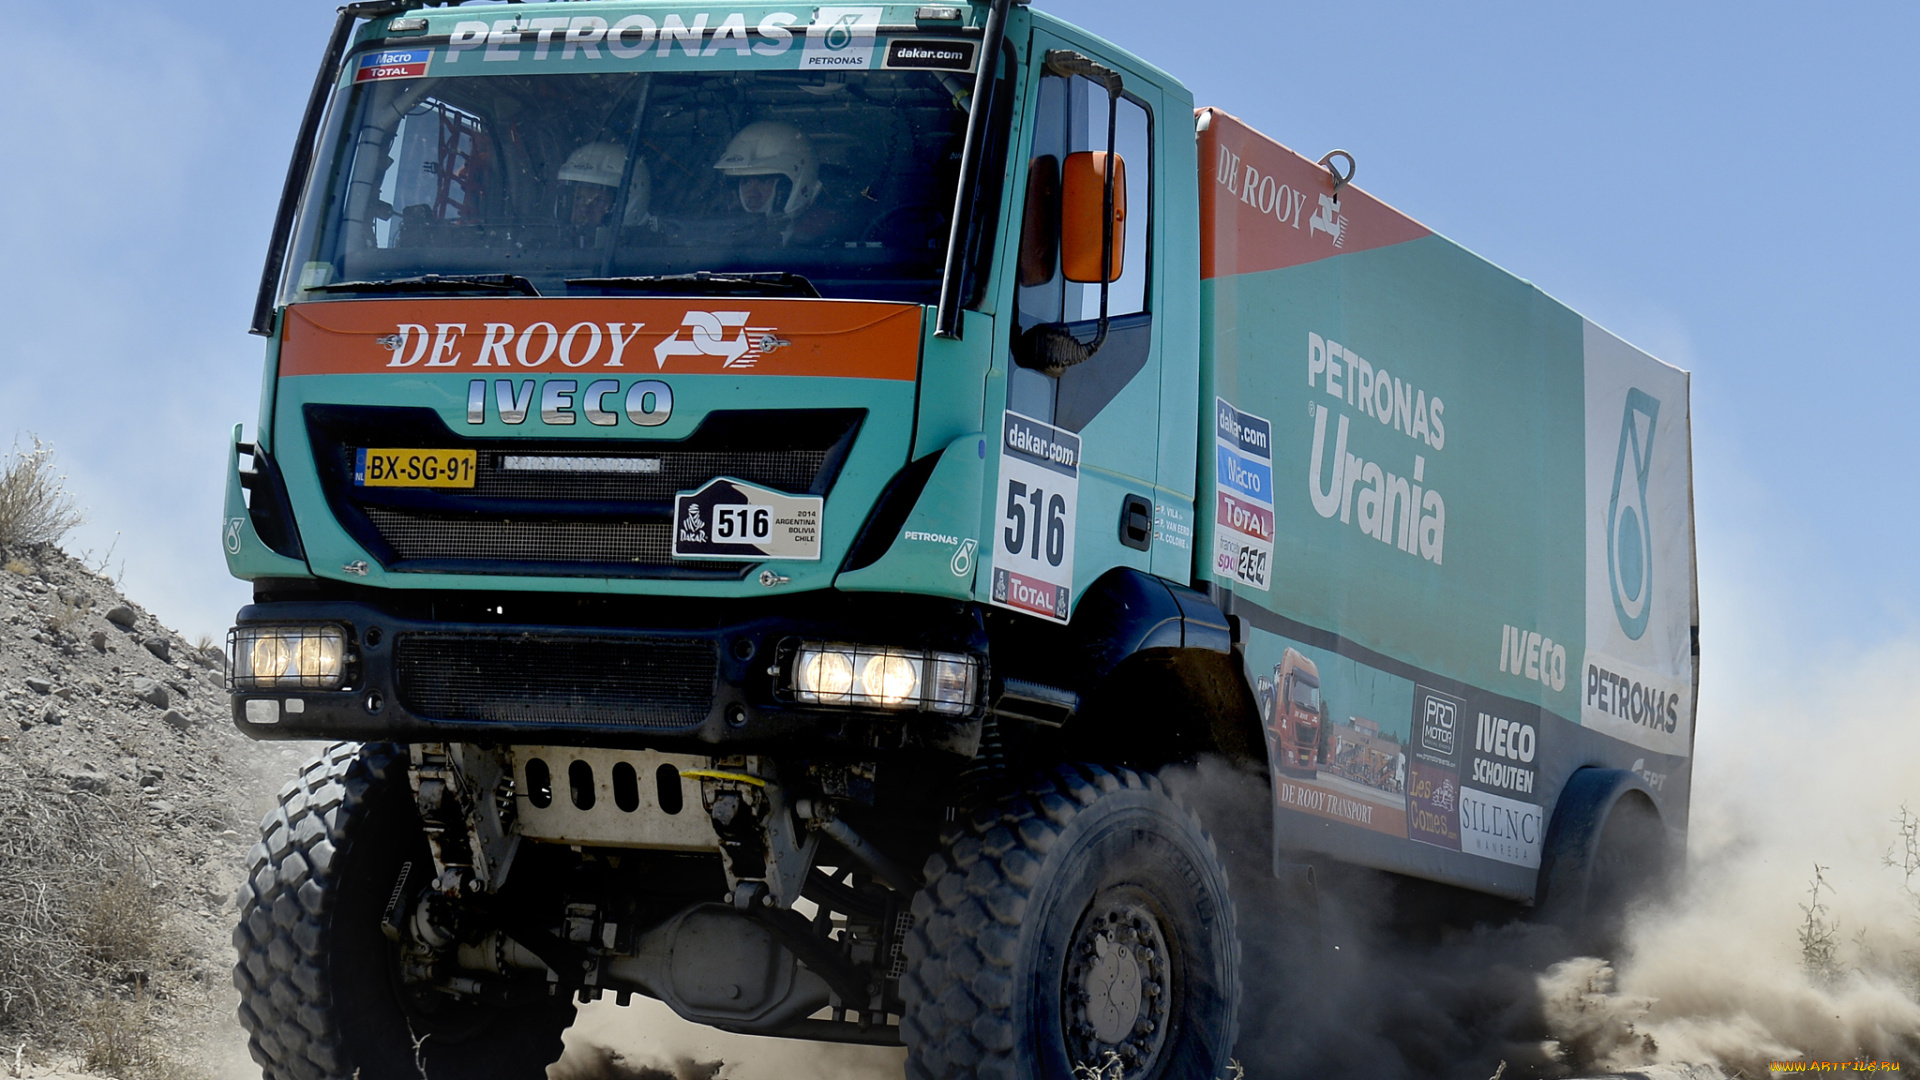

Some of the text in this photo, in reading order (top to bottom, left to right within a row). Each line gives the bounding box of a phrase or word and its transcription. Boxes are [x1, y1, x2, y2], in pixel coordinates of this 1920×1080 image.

[445, 12, 798, 63] PETRONAS
[897, 48, 963, 60] dakar.com
[375, 53, 412, 64] Macro
[808, 56, 864, 65] PETRONAS
[1217, 144, 1307, 229] DE ROOY
[386, 322, 646, 367] DE ROOY
[467, 379, 674, 427] IVECO
[1308, 331, 1446, 451] PETRONAS
[1009, 423, 1075, 466] dakar.com
[1219, 408, 1267, 449] dakar.com
[355, 455, 470, 481] NL BX-SG-91
[1227, 456, 1261, 493] Macro
[1309, 404, 1446, 566] Urania
[717, 509, 769, 538] 516
[775, 518, 816, 526] ARGENTINA
[904, 531, 958, 545] PETRONAS
[1004, 479, 1066, 567] 516
[1011, 578, 1054, 610] TOTAL
[1499, 624, 1567, 692] IVECO
[1587, 664, 1680, 734] PETRONAS
[1425, 725, 1452, 744] MOTOR
[1475, 712, 1536, 763] IVECO
[1410, 771, 1432, 799] Les
[1472, 757, 1534, 794] SCHOUTEN
[1281, 783, 1373, 825] DE ROOY TRANSPORT
